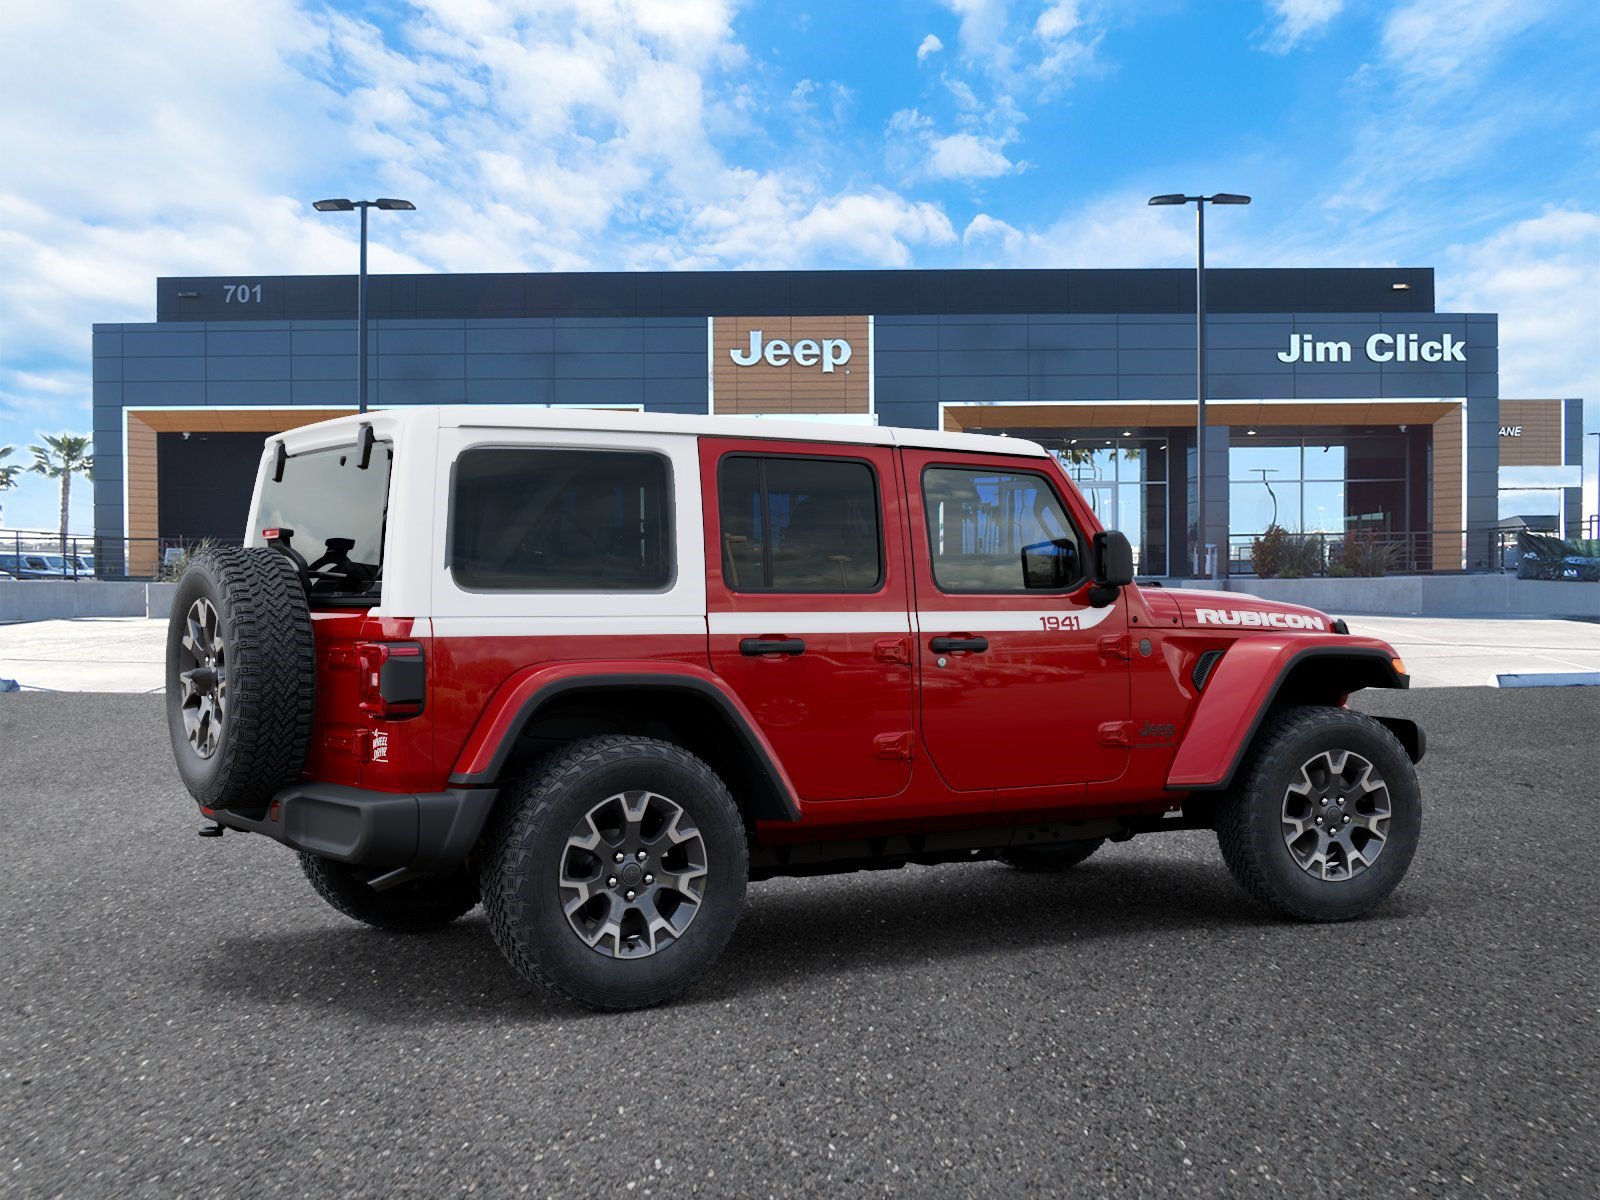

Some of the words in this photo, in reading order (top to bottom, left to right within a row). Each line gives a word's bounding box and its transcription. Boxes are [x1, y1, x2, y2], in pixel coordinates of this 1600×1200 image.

[223, 284, 262, 304] 701
[729, 330, 852, 373] Jeep
[1277, 333, 1352, 363] Jim
[1366, 333, 1467, 362] Click
[1039, 615, 1081, 631] 1941
[1194, 608, 1325, 631] RUBICON
[1139, 719, 1175, 740] Jeep
